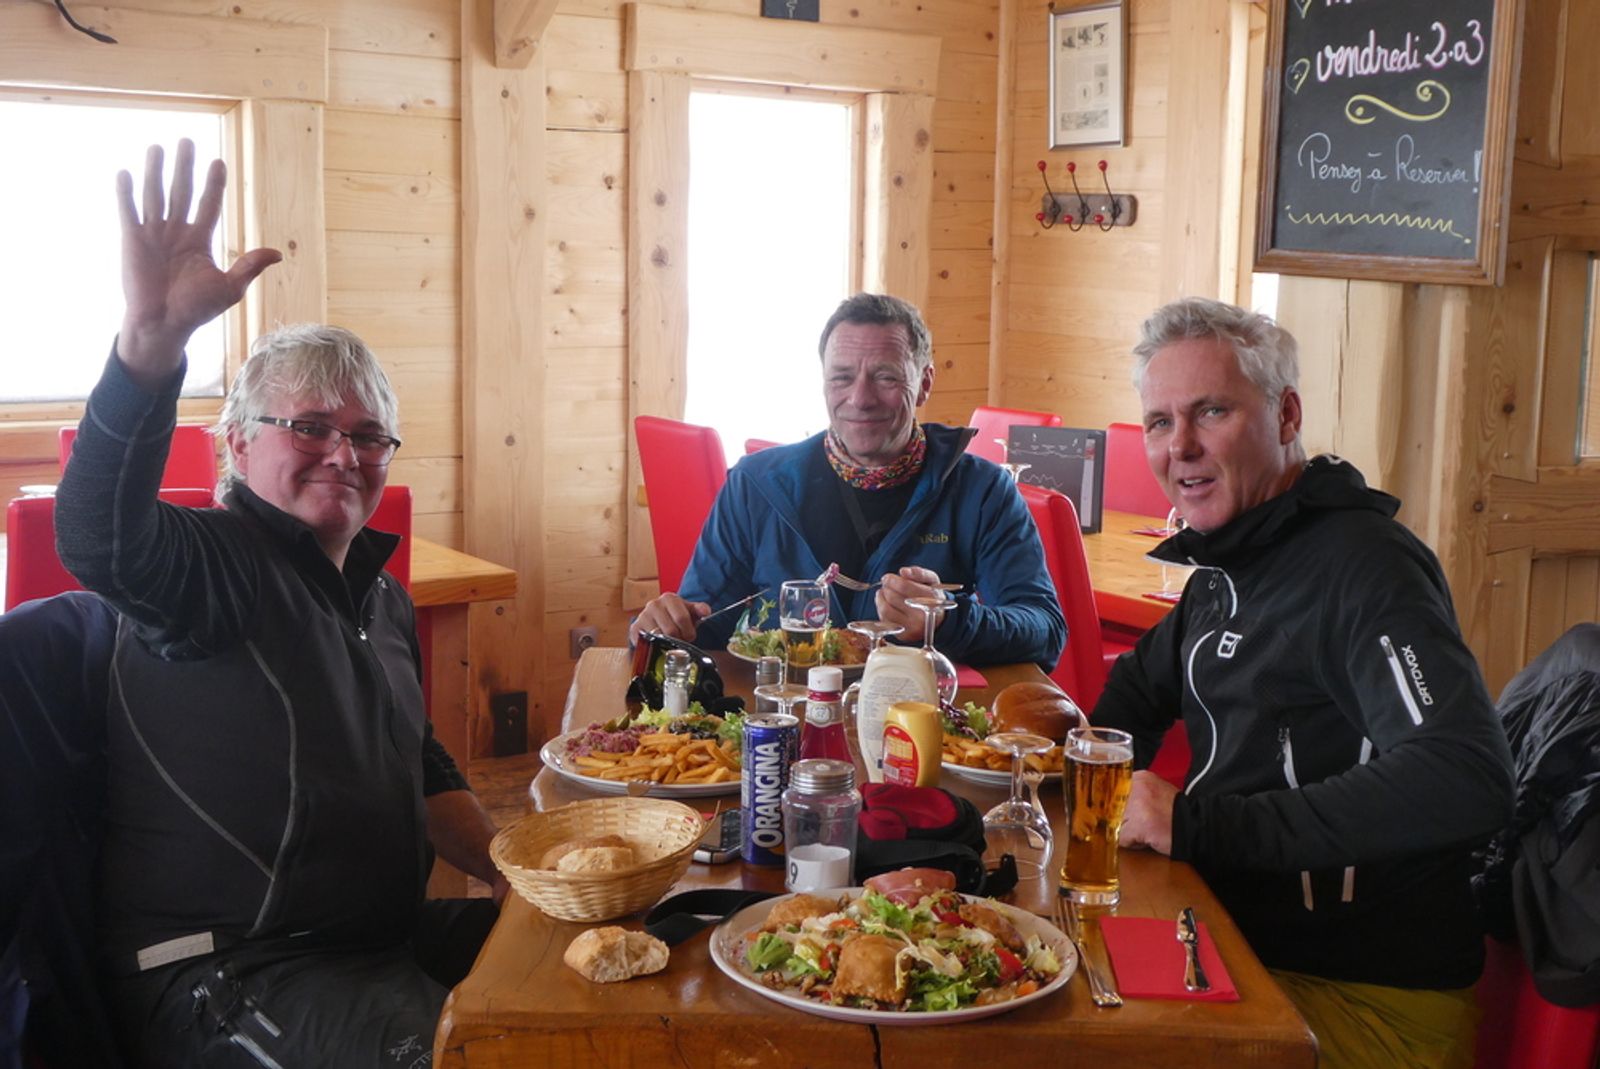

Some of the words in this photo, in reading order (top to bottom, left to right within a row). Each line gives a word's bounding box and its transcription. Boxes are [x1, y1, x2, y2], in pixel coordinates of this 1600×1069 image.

[1316, 29, 1422, 82] vendredi
[1298, 132, 1362, 193] Pensez
[1401, 645, 1434, 705] ORTOVOX
[752, 741, 784, 848] ORANGINA
